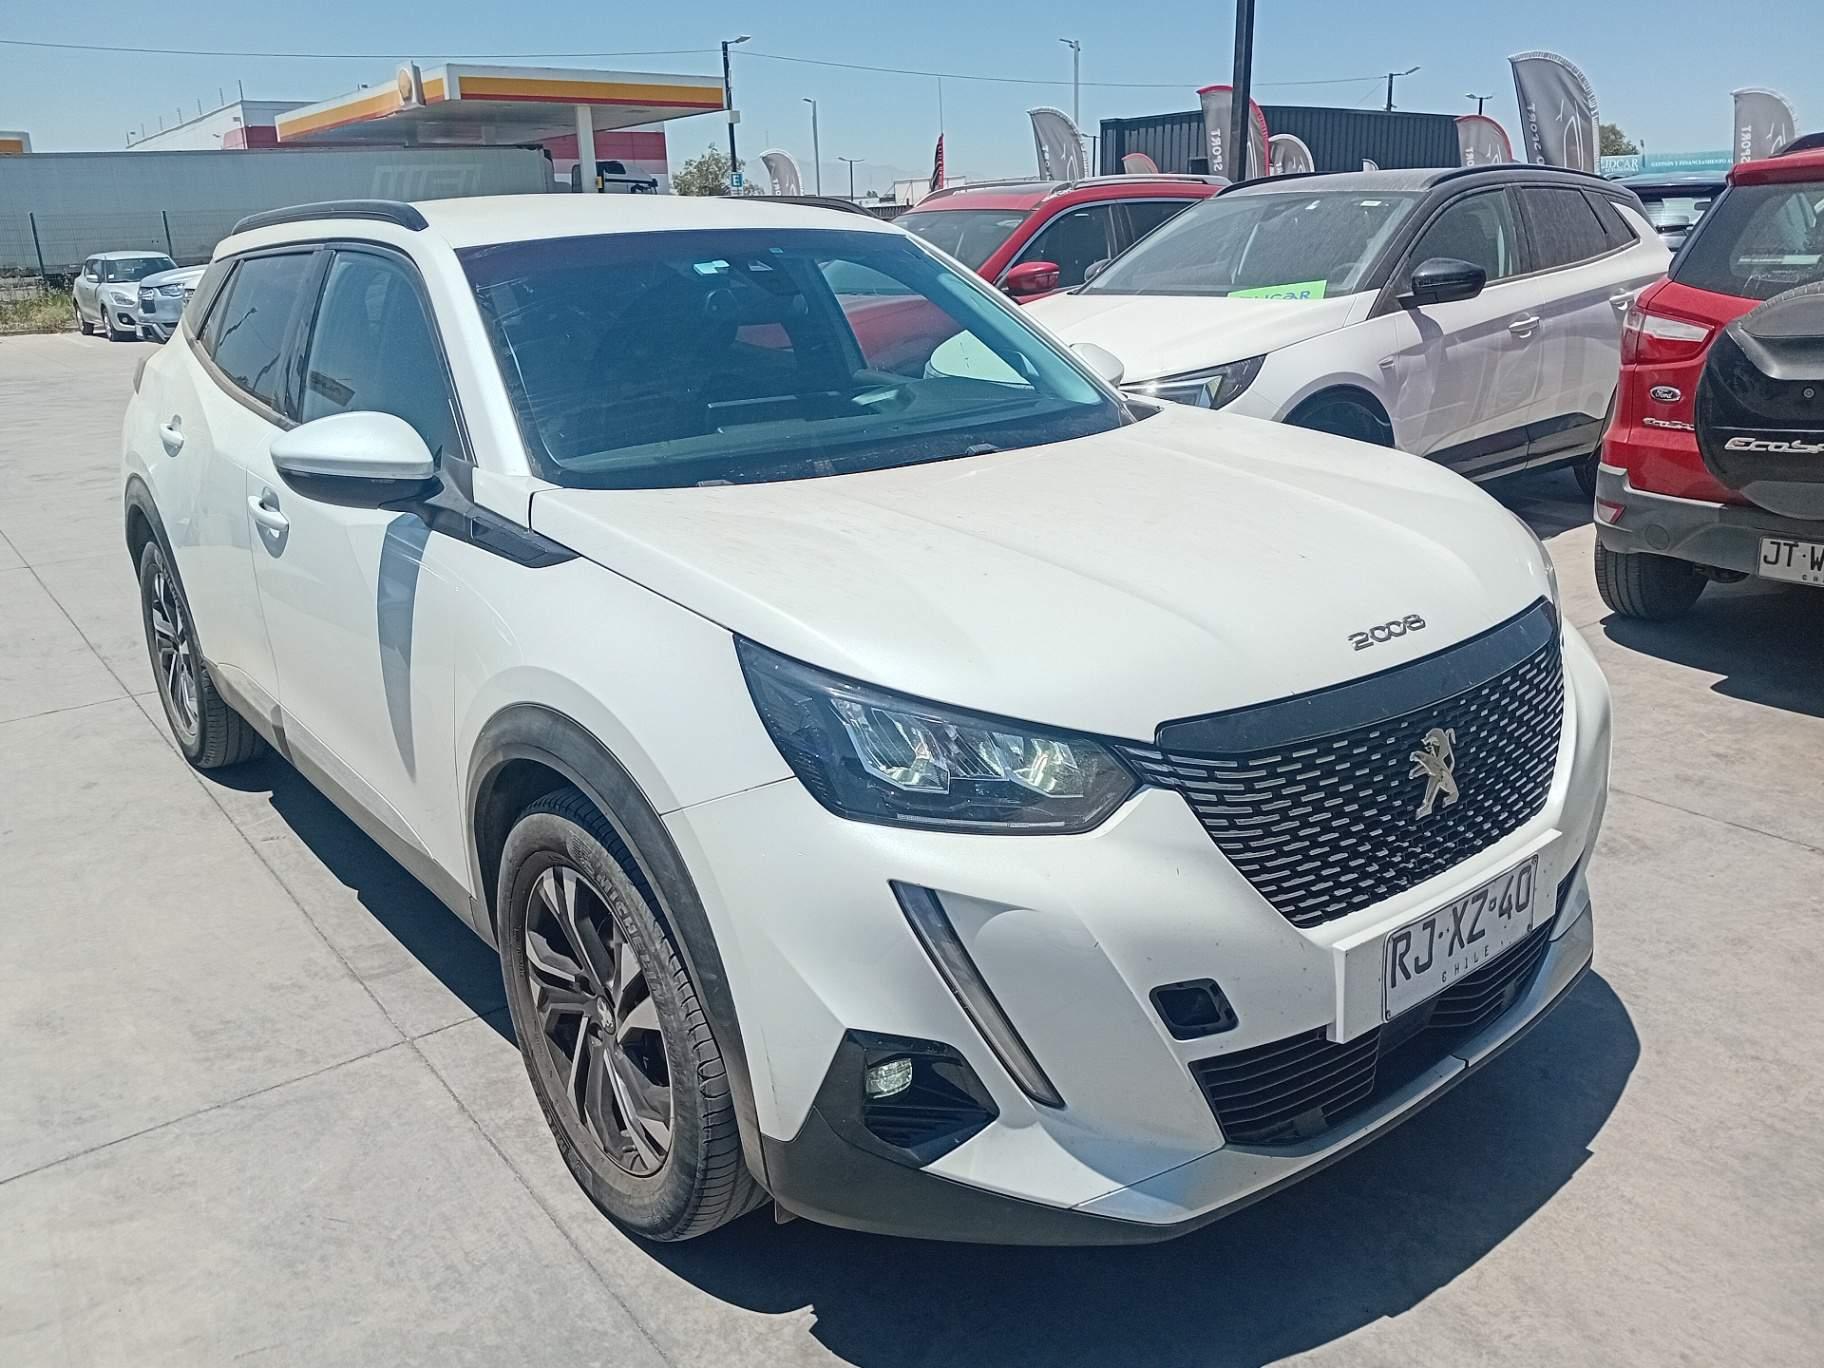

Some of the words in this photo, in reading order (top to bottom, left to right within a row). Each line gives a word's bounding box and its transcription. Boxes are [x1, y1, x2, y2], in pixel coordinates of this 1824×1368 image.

[1655, 389, 1674, 399] Ford
[1348, 614, 1426, 651] 2008
[1442, 945, 1489, 983] CHILE
